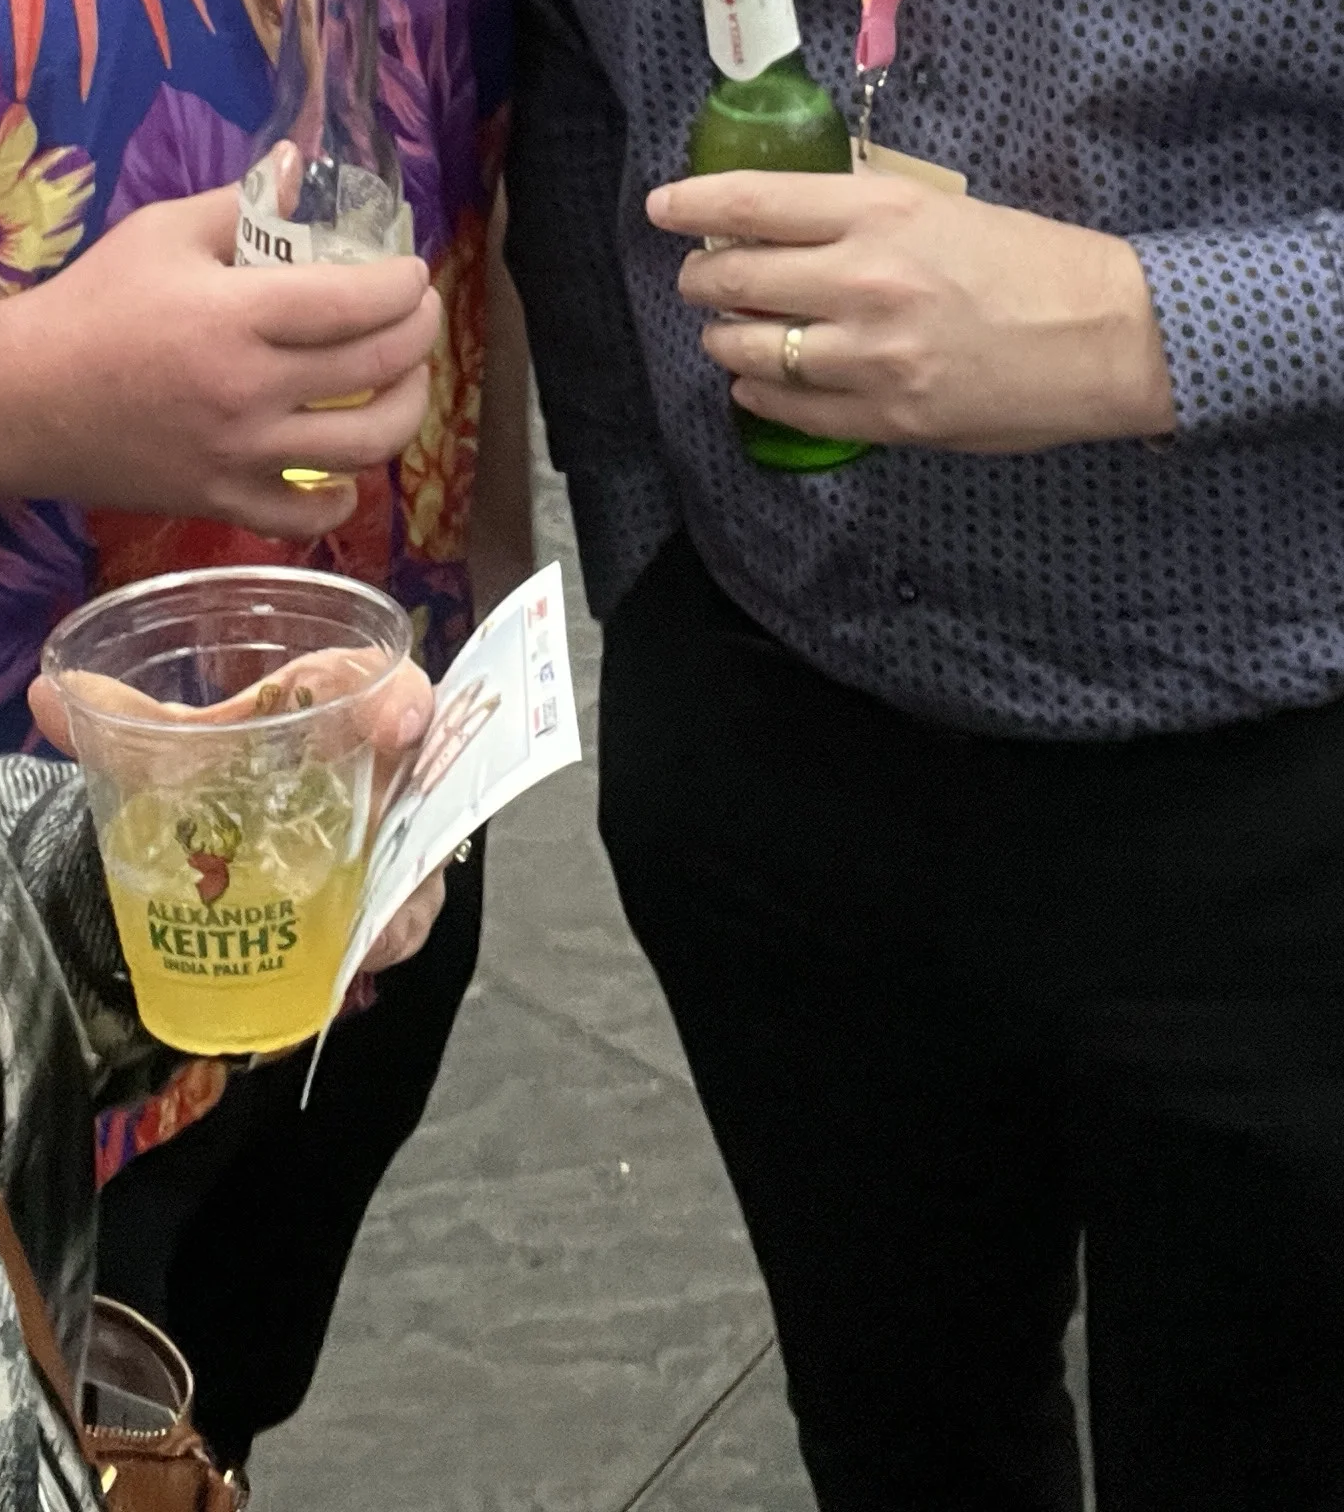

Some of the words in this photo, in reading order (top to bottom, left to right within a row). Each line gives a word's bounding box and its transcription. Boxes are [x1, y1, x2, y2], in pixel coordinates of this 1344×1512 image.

[242, 216, 294, 264] ona
[147, 899, 294, 927] ALEXANDER
[149, 918, 298, 959] KEITH'S
[163, 956, 208, 975] INDIA
[213, 961, 252, 977] PALE
[257, 954, 285, 973] ALE
